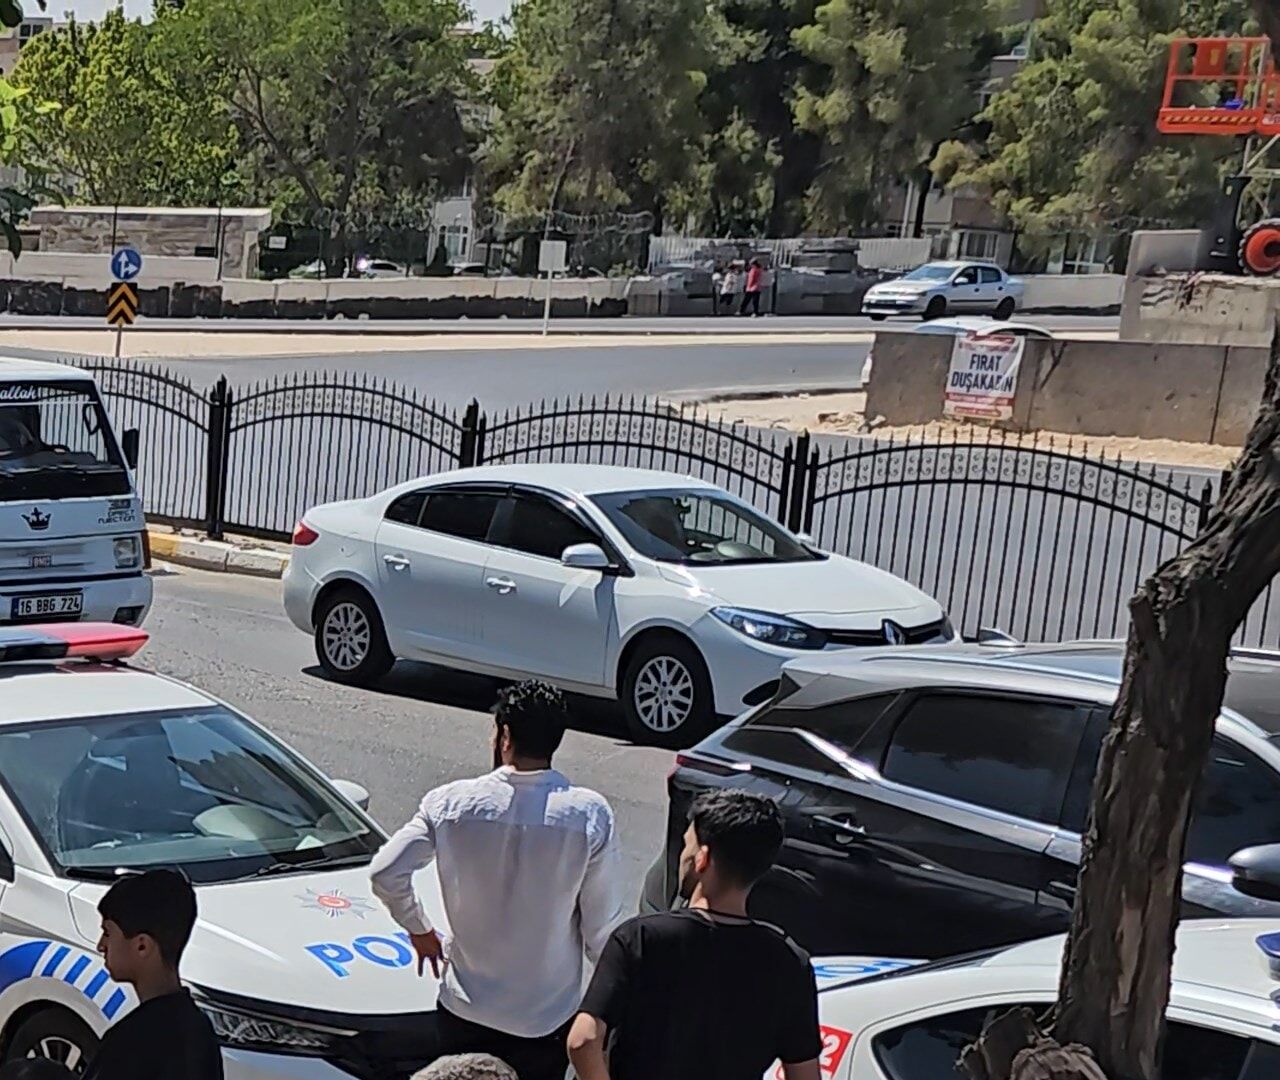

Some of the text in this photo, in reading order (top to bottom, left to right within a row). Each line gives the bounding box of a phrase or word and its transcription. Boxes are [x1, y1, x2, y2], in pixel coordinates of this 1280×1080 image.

[969, 354, 1002, 371] FIRAT
[21, 600, 32, 613] 16
[61, 597, 79, 610] 724
